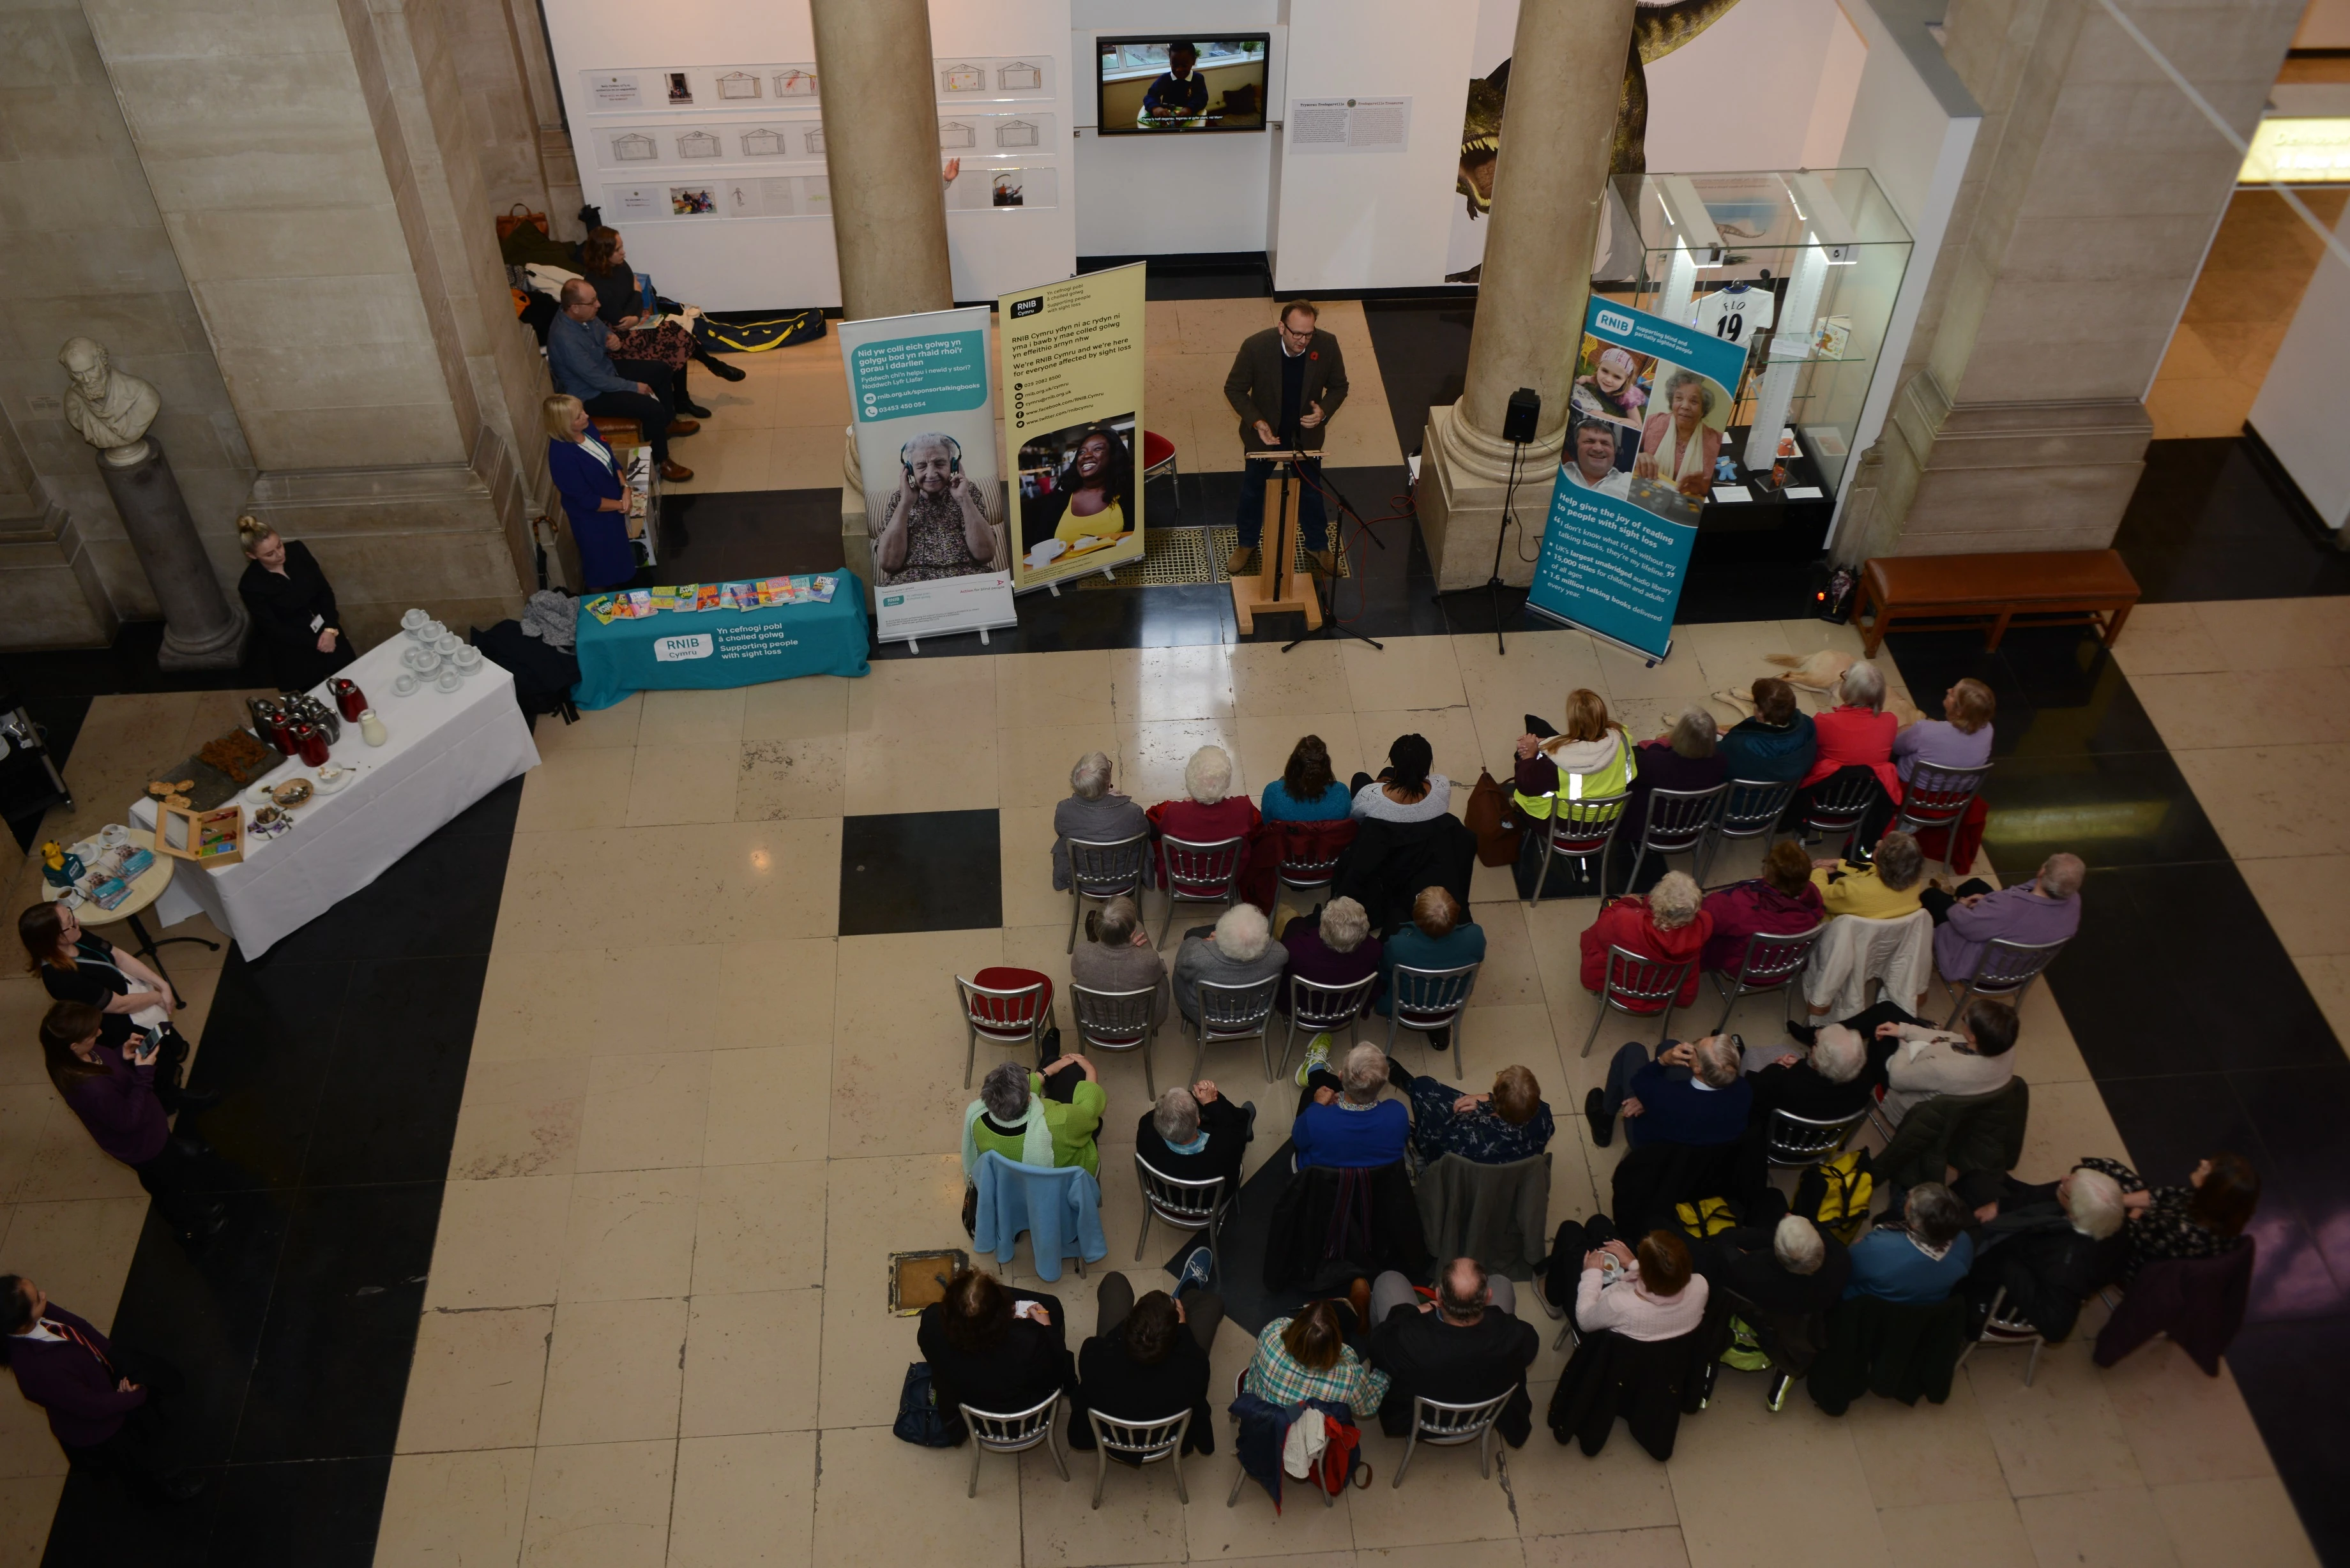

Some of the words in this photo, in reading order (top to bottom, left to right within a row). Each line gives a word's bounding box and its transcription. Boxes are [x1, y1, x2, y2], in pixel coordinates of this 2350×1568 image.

[1054, 287, 1072, 295] cefnogi
[1017, 300, 1036, 310] RNIB
[1047, 298, 1073, 308] Supporting
[1724, 301, 1746, 311] FLO
[1031, 329, 1054, 339] Cymru
[1056, 324, 1072, 334] ydyn
[1093, 315, 1112, 324] rydyn
[1601, 314, 1628, 331] RNIB
[1718, 313, 1742, 342] 19
[1012, 343, 1027, 352] yma
[1033, 337, 1052, 346] bawb
[1076, 326, 1097, 335] colled
[1099, 321, 1120, 331] golwg
[1636, 326, 1664, 339] supporting
[1664, 334, 1678, 342] blind
[887, 345, 904, 353] colli
[925, 341, 950, 350] golwg
[1023, 345, 1052, 356] effeithio
[1054, 340, 1073, 349] arnyn
[1635, 332, 1656, 342] partially
[1656, 338, 1676, 348] sighted
[1676, 345, 1692, 355] people
[859, 356, 887, 367] golygu
[941, 347, 962, 355] rhoi'r
[1013, 361, 1033, 370] We're
[1036, 356, 1052, 365] RNIB
[1054, 351, 1075, 360] Cymru
[1093, 342, 1111, 350] we're
[1026, 363, 1057, 375] everyone
[1059, 356, 1087, 366] affected
[1098, 348, 1116, 357] sight
[860, 365, 884, 375] gorau
[890, 359, 923, 369] ddarllen
[861, 375, 889, 383] Fyddwch
[906, 370, 924, 378] helpu
[862, 381, 891, 389] Noddwch
[877, 383, 980, 400] rnib.org.uk/sponsortalkingbooks
[1025, 382, 1069, 398] rnib.org.uk/cymru
[1026, 389, 1072, 407] cymru@rnib.org.uk
[1026, 392, 1103, 416] www.facebook.com/RNIB.Cymru
[1026, 403, 1094, 425] www.twitter.com/rnibcymru
[1558, 503, 1565, 511] to
[1567, 508, 1596, 523] people
[1598, 518, 1618, 530] with
[1619, 526, 1640, 540] sight
[1641, 535, 1658, 548] loss
[1559, 492, 1578, 506] Help
[1580, 502, 1598, 513] give
[1600, 508, 1615, 518] the
[1615, 514, 1630, 524] joy
[1642, 526, 1674, 545] reading
[1558, 531, 1581, 545] talking
[1582, 539, 1605, 552] books,
[1606, 548, 1629, 561] they're
[1630, 557, 1640, 568] my
[1565, 522, 1582, 534] don't
[1582, 529, 1602, 539] know
[1603, 536, 1619, 547] what
[1639, 551, 1664, 566] without
[1553, 553, 1577, 568] 15,000
[1578, 563, 1596, 574] titles
[1597, 569, 1606, 577] for
[1607, 573, 1632, 589] children
[1632, 584, 1644, 595] and
[1644, 589, 1665, 603] adults
[1555, 544, 1569, 555] UK's
[1570, 550, 1594, 563] largest
[1595, 559, 1633, 578] unabridged
[1632, 575, 1651, 587] audio
[1651, 583, 1672, 596] library
[1568, 571, 1582, 580] ages
[1547, 581, 1565, 593] every
[1565, 589, 1581, 599] year.
[1550, 572, 1560, 581] 1.6
[1561, 577, 1585, 590] million
[1586, 585, 1610, 601] talking
[1611, 595, 1632, 610] books
[1632, 606, 1663, 622] delivered
[726, 633, 756, 642] cholled
[759, 631, 784, 640] golwg
[730, 624, 761, 633] cefnogi
[667, 638, 699, 650] RNIB
[720, 642, 767, 652] Supporting
[769, 639, 798, 649] people
[669, 650, 697, 658] Cymru
[741, 649, 762, 658] sight
